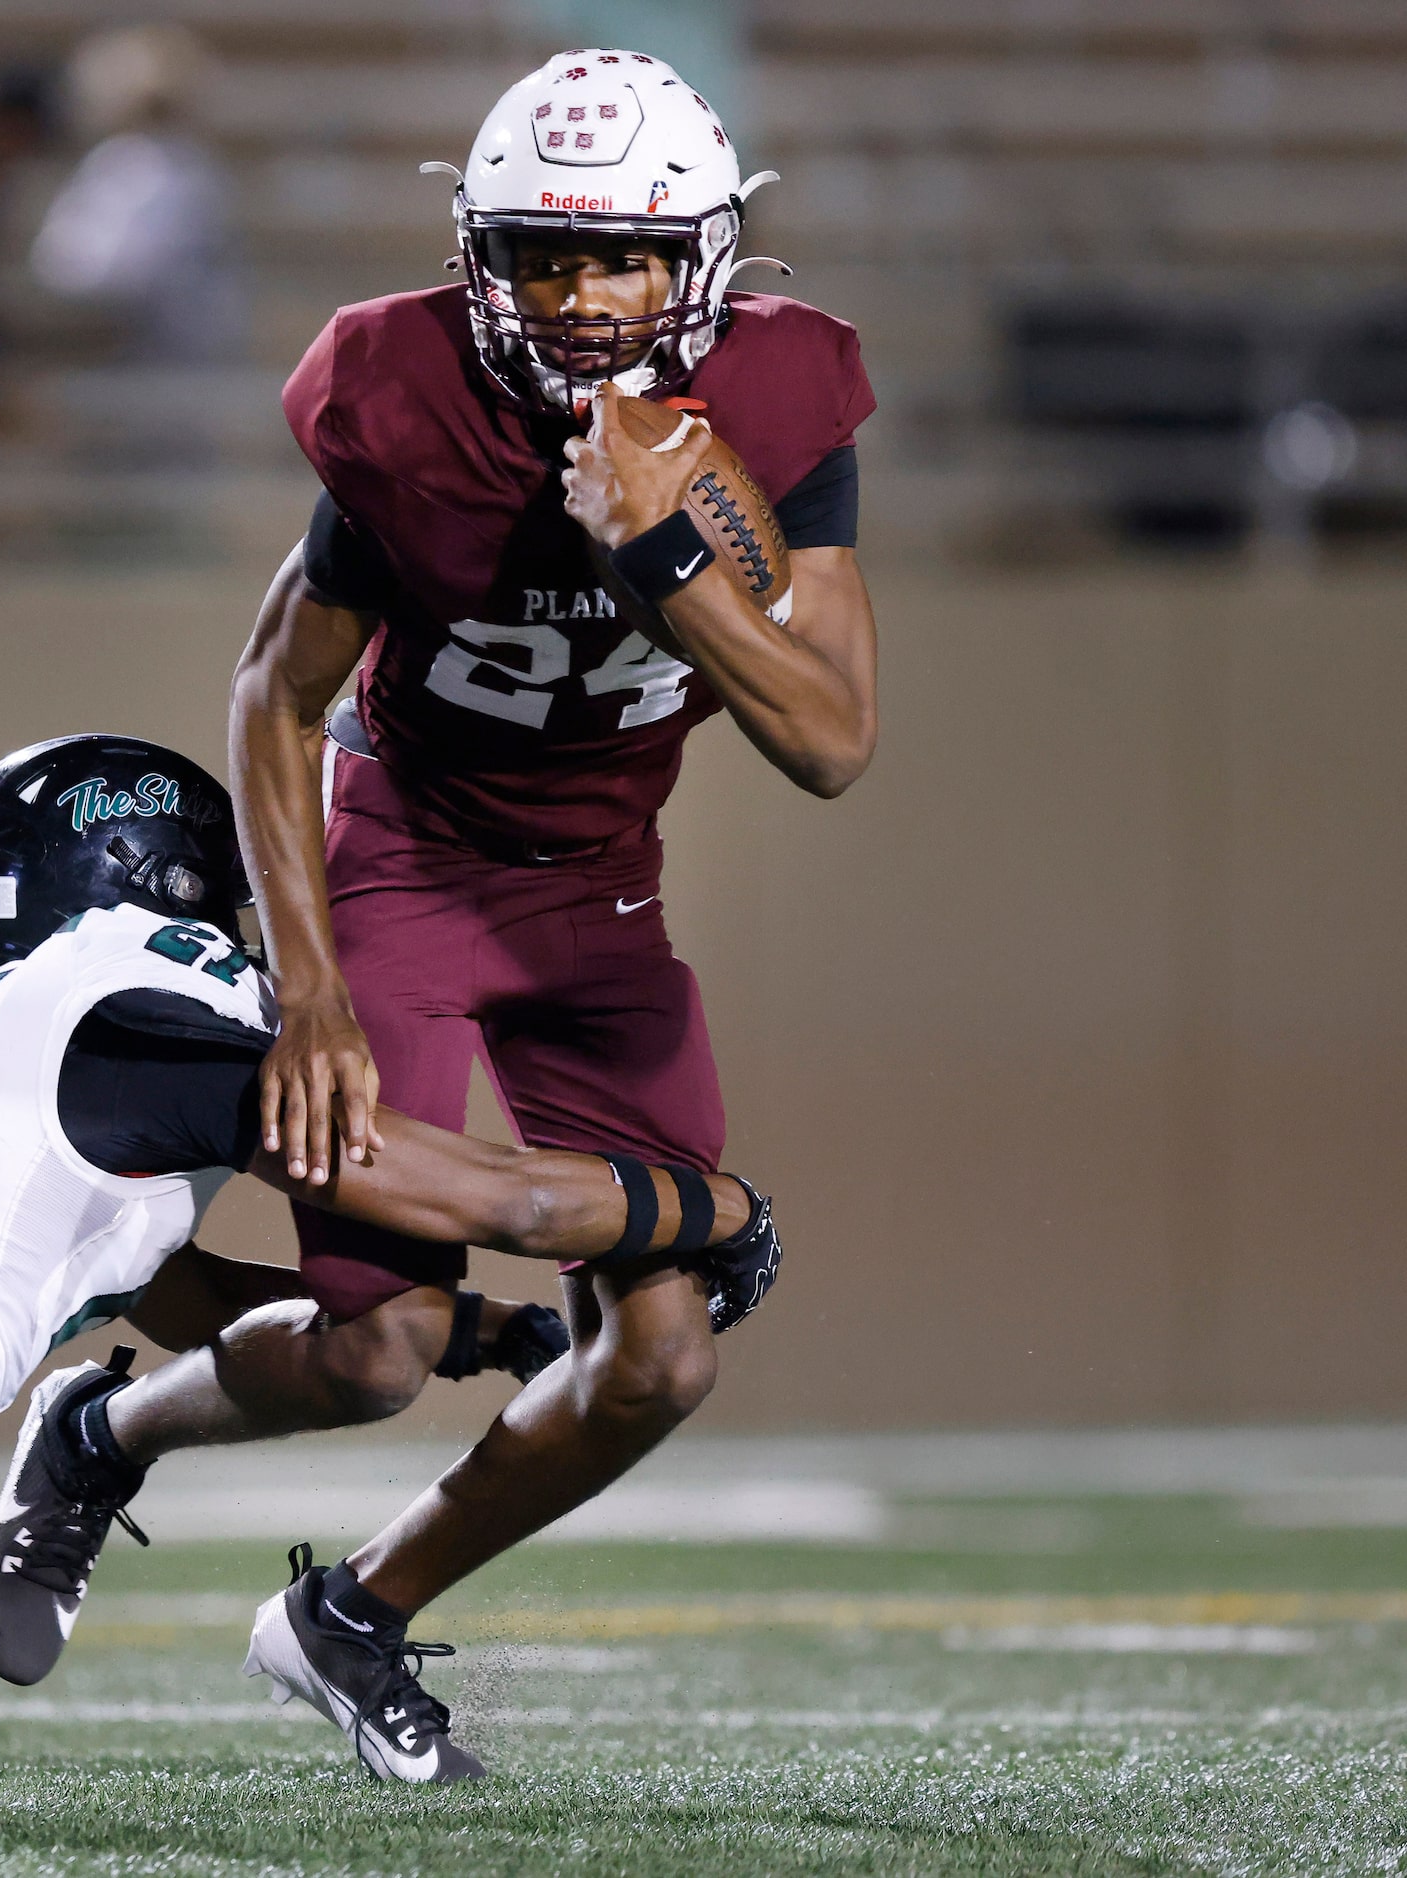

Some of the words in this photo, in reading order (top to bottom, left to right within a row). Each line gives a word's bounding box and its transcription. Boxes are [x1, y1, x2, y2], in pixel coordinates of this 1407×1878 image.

[541, 191, 613, 211] Riddell
[424, 618, 693, 730] 24
[143, 916, 251, 988] 21
